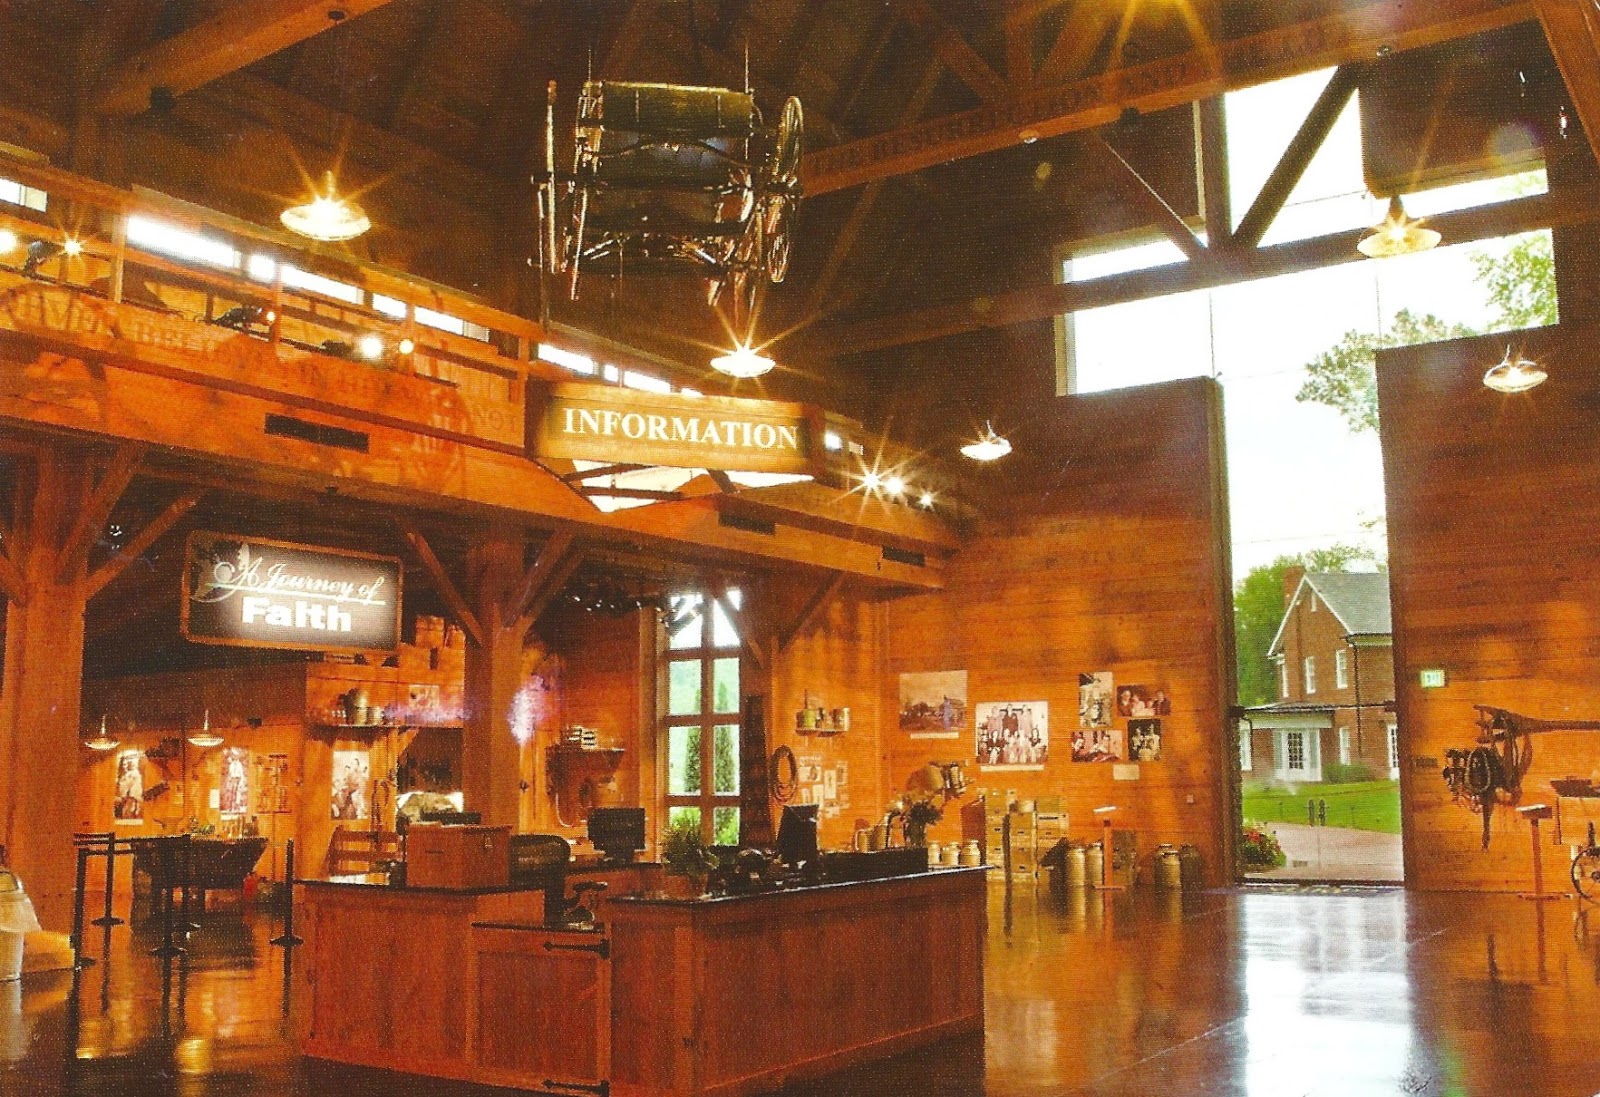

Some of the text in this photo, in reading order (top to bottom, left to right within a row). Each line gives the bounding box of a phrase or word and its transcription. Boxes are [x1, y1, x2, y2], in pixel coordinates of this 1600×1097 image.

[562, 408, 798, 450] INFORMATION
[259, 563, 354, 602] Journey
[358, 576, 385, 604] of
[242, 596, 351, 632] Faith
